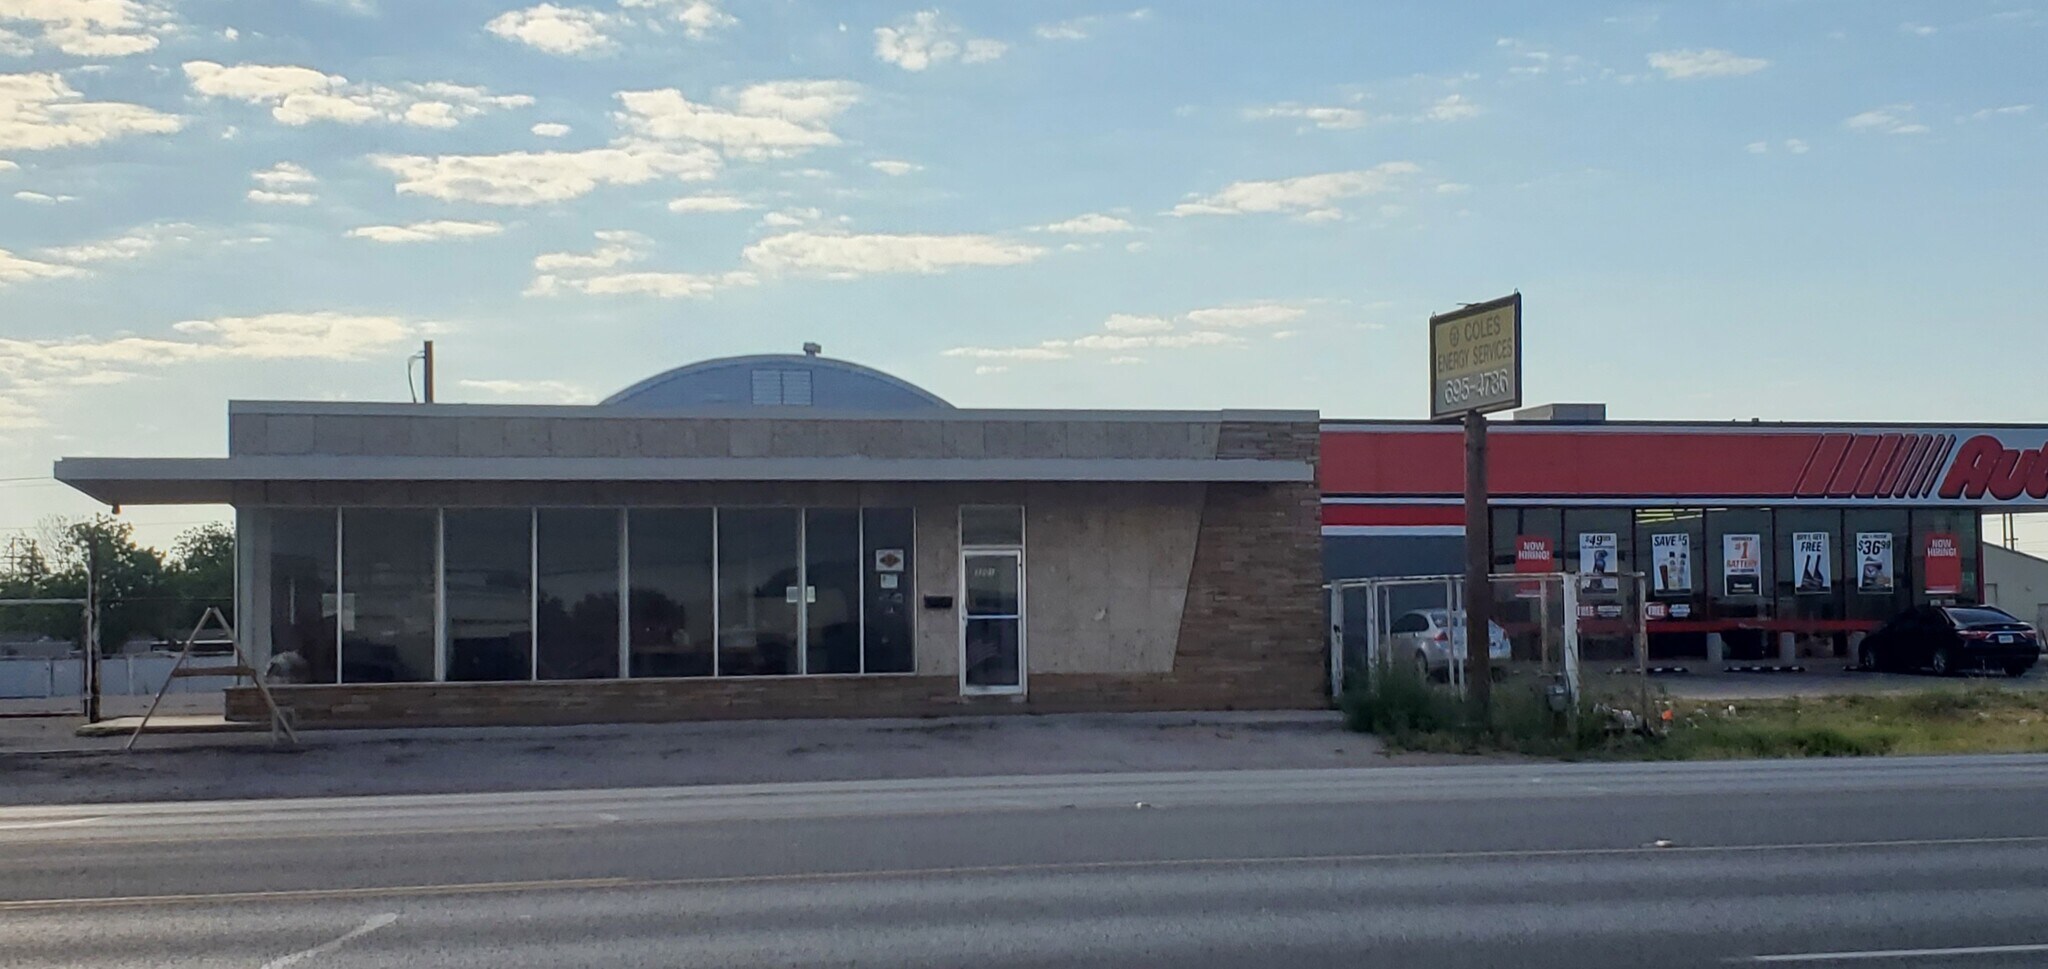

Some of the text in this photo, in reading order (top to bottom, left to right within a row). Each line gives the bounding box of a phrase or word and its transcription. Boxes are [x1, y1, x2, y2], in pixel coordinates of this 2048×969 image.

[1464, 315, 1501, 342] COLES
[1438, 337, 1513, 373] ENERGY SERVICES
[1523, 541, 1545, 551] NOW
[1654, 535, 1676, 547] SAVE
[1932, 539, 1952, 548] NOW
[1801, 541, 1822, 552] FREE
[1518, 550, 1550, 560] HIRING!
[1727, 560, 1757, 568] BATTERY
